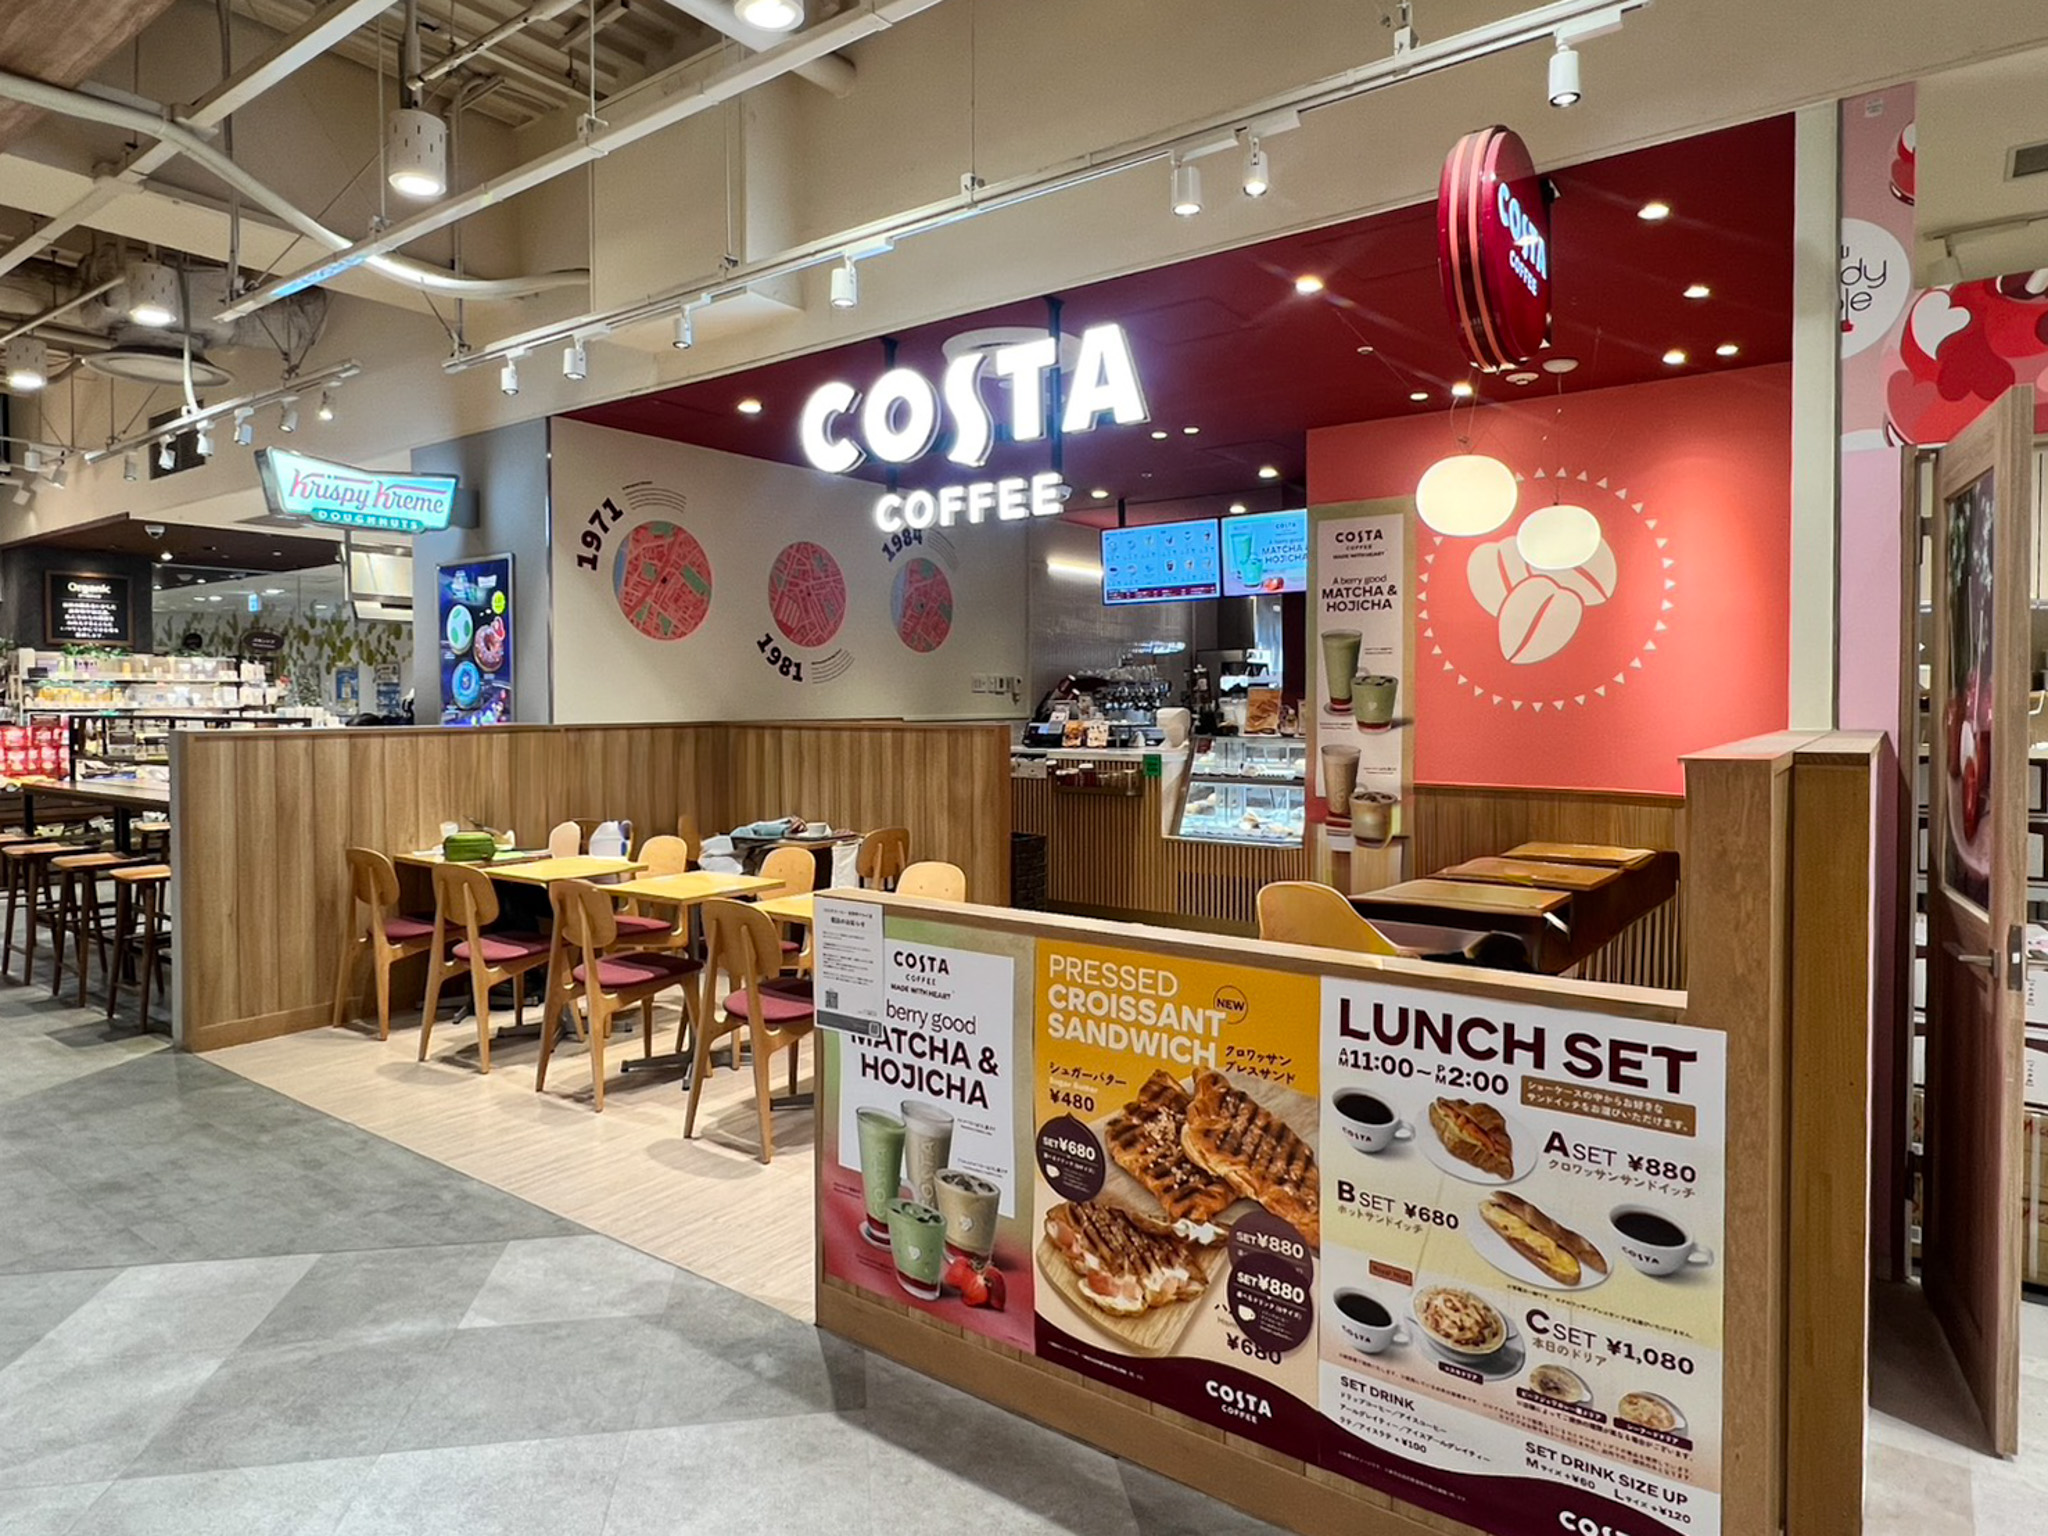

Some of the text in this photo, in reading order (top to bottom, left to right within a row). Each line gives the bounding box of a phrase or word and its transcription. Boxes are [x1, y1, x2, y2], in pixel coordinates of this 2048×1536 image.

[1498, 182, 1547, 280] COSTA
[1509, 249, 1538, 297] COFFEE
[800, 323, 1150, 473] COSTA
[289, 468, 448, 514] Krispy Kreme
[875, 471, 1065, 533] COFFEE
[317, 509, 418, 530] DOUGHNUTS
[577, 497, 624, 571] 1971
[882, 528, 923, 562] 1984
[1262, 544, 1303, 555] MATCHA
[1335, 528, 1383, 543] COSTA
[1322, 584, 1397, 600] MATCHA &
[1333, 574, 1387, 586] A berry good
[1326, 599, 1392, 613] HOJICHA
[756, 633, 803, 683] 1981
[894, 951, 949, 975] COSTA
[1049, 954, 1179, 997] PRESSED
[891, 983, 951, 1000] MADE WITH HEART
[906, 973, 936, 986] COFFEE
[886, 998, 976, 1035] berry good
[1048, 983, 1226, 1037] CROISSANT
[1217, 998, 1245, 1011] NEW
[1048, 1012, 1216, 1070] SANDWICH
[1226, 1045, 1292, 1066] クロワッサン
[1340, 997, 1697, 1094] LUNCH SET
[978, 1046, 999, 1076] &
[1049, 1061, 1127, 1086] シュガーバター
[861, 1052, 988, 1109] HOJICHA
[1049, 1088, 1094, 1112] ¥480
[1342, 1126, 1372, 1143] COSTA
[1548, 1159, 1696, 1198] クロワッサンサンドイッチ
[1628, 1153, 1697, 1183] ¥880
[1337, 1179, 1459, 1230] B SET ¥680
[1338, 1204, 1423, 1234] ホットサンドイッチ
[1621, 1246, 1659, 1264] COSTA
[1342, 1325, 1371, 1343] COSTA
[1525, 1308, 1694, 1375] C SET ¥1,080
[1531, 1336, 1607, 1366] 本日のドリア
[1205, 1380, 1272, 1418] COSTA
[1340, 1375, 1367, 1394] SET
[1370, 1386, 1415, 1411] DRINK
[1221, 1404, 1257, 1424] COFFEE
[1526, 1441, 1689, 1505] SET DRINK SIZE UP
